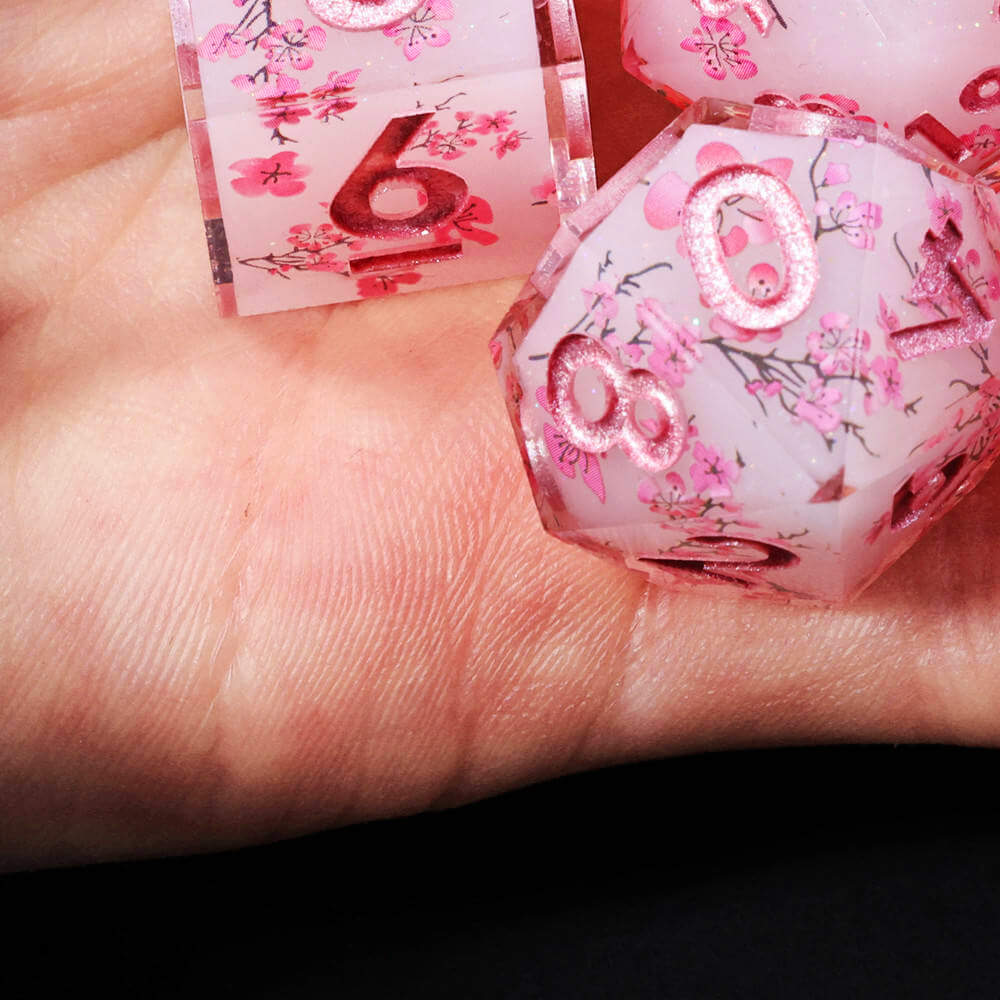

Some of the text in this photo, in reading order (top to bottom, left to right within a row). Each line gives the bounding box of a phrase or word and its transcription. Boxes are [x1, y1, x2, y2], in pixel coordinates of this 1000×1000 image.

[328, 111, 469, 276] 6
[680, 163, 820, 331] 0
[545, 333, 687, 472] 8
